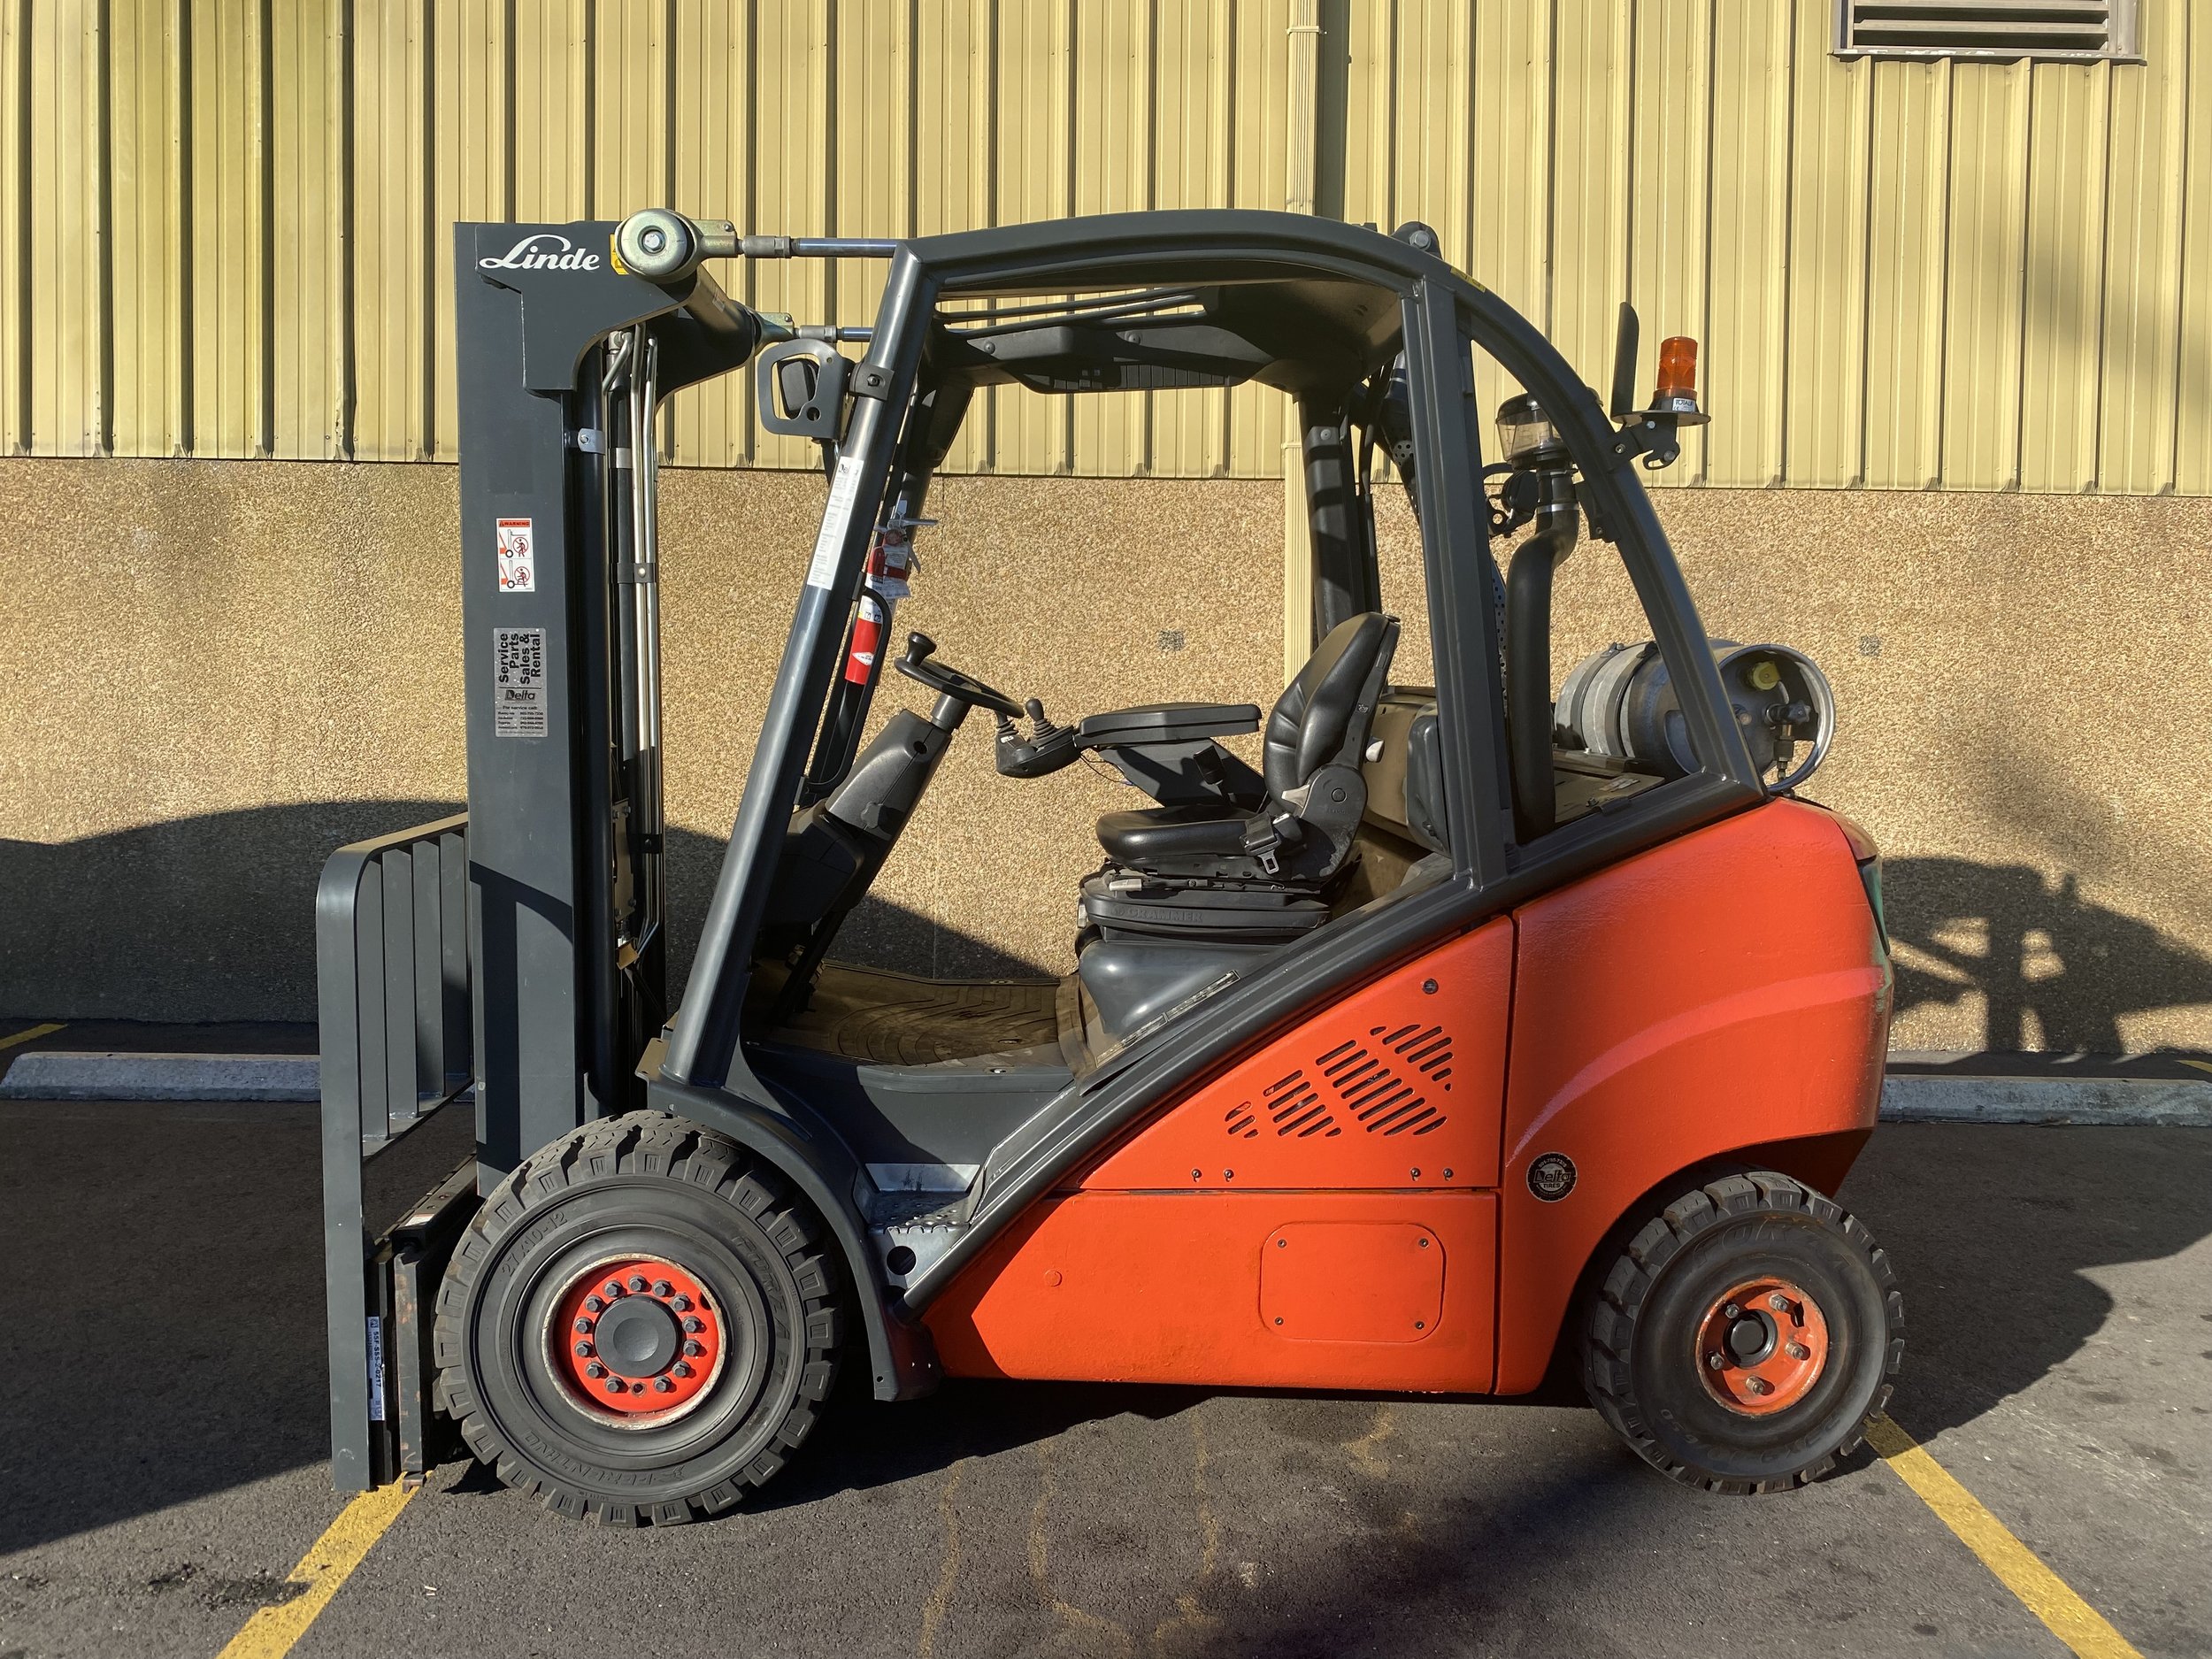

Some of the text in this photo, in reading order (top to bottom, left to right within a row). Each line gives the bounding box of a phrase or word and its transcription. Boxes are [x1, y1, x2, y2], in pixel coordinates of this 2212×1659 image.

[479, 234, 600, 271] Linde
[498, 633, 509, 683] Service
[509, 633, 519, 669] Parts
[519, 634, 530, 685] Sales &
[530, 634, 541, 678] Rental
[504, 689, 535, 701] Delta
[1534, 1170, 1570, 1182] Delta
